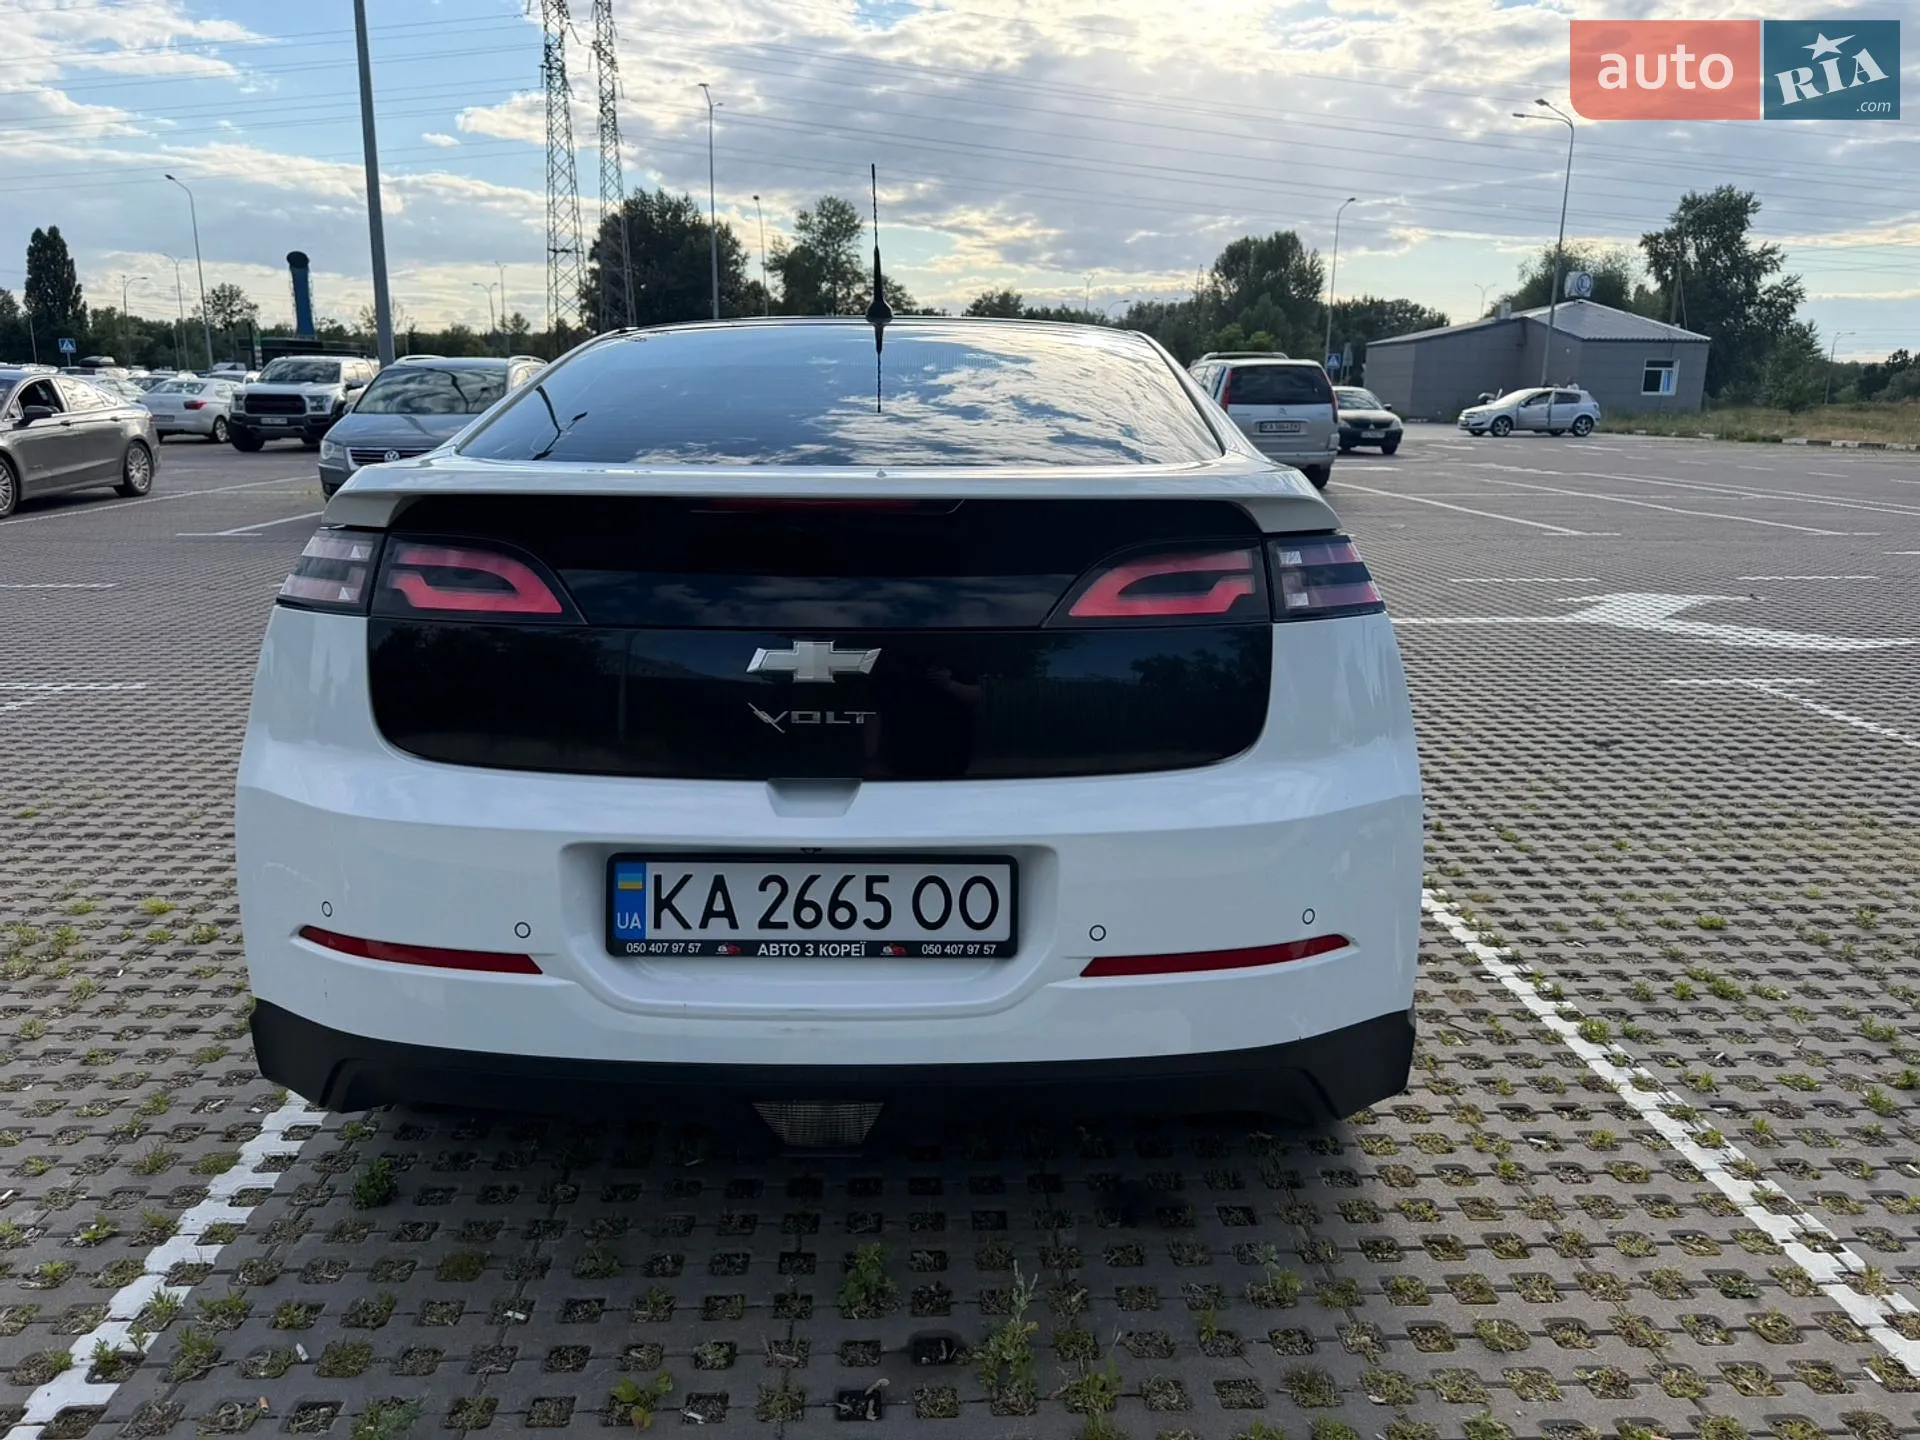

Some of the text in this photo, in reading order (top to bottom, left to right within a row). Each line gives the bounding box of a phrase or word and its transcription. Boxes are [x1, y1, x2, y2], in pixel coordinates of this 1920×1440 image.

[748, 702, 877, 733] VOLT
[652, 874, 739, 931] KA
[757, 874, 892, 931] 2665
[617, 912, 642, 929] UA
[626, 942, 701, 954] 050 407 97 57
[757, 943, 800, 956] АВТО
[819, 941, 867, 956] КОРЕЇ
[921, 944, 996, 955] 050 407 97 57
